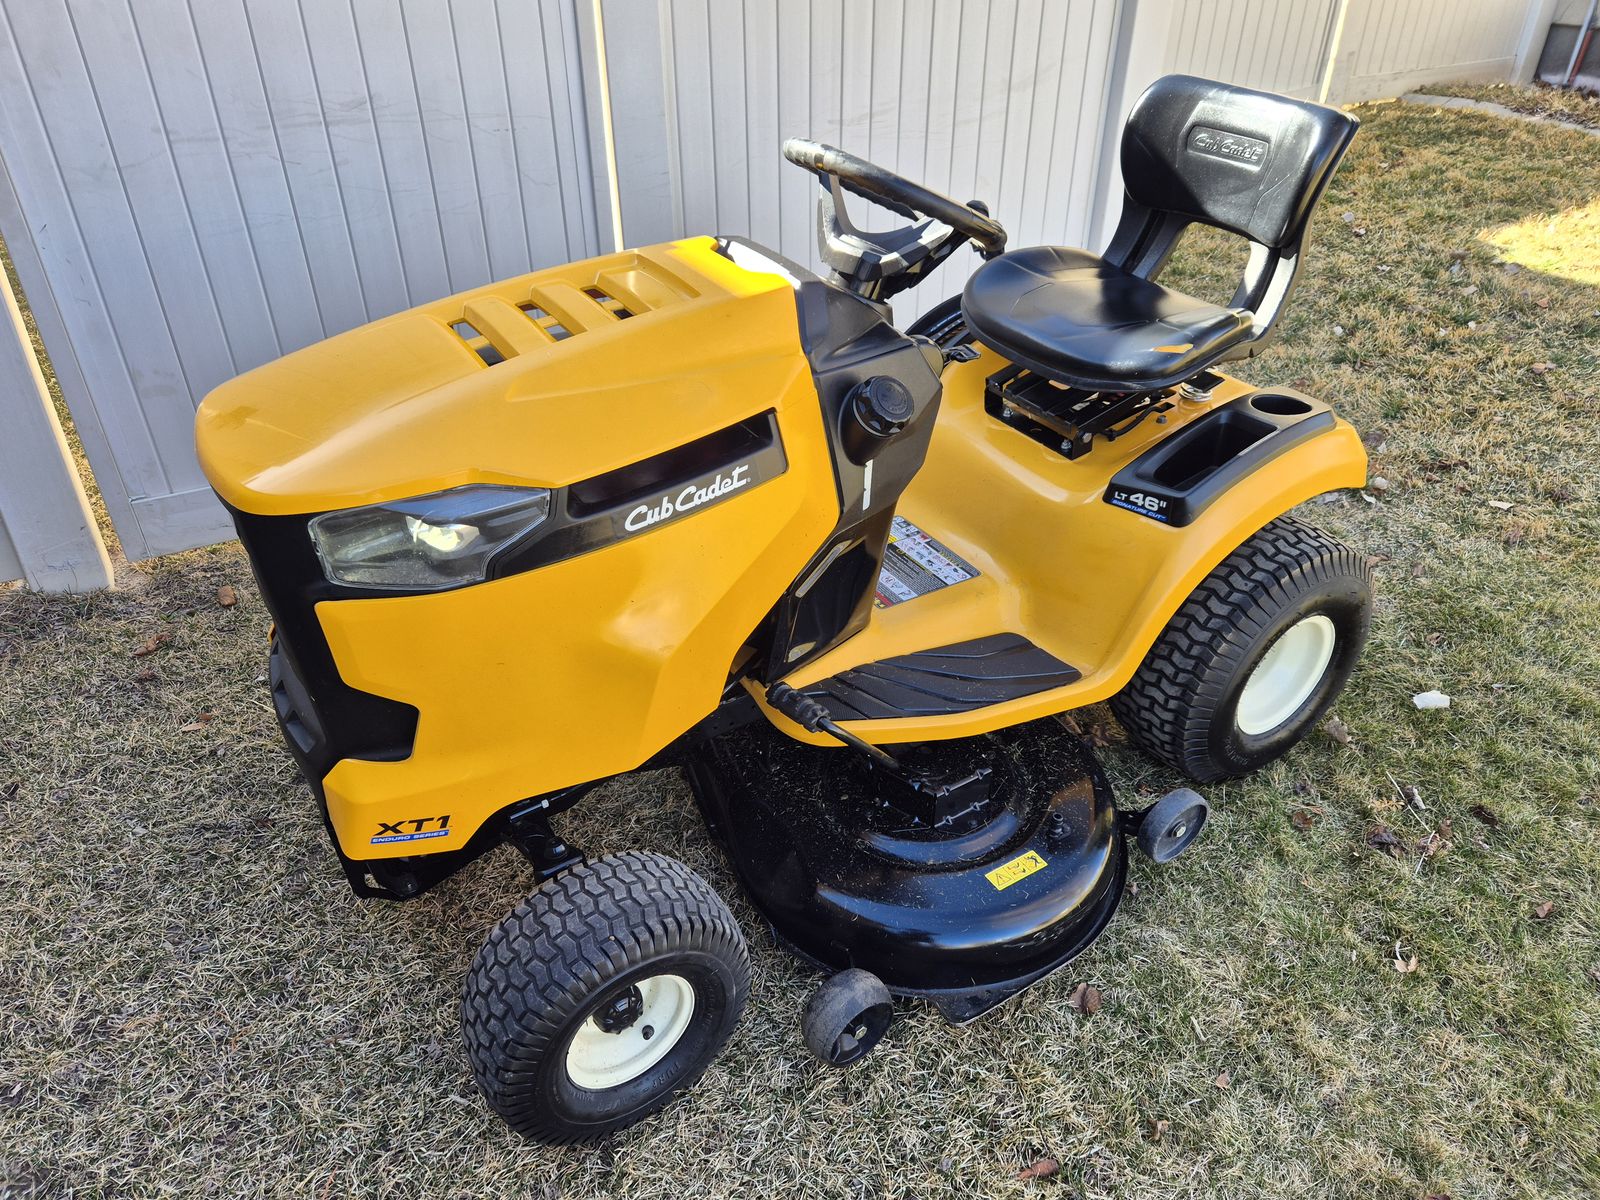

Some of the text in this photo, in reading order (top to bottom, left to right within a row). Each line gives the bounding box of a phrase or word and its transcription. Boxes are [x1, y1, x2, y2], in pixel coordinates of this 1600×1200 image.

[1219, 139, 1263, 161] Cadet
[624, 464, 749, 532] Cub Cadet
[1111, 499, 1148, 515] SIGNATURE
[1114, 490, 1168, 512] LT 46"
[372, 815, 451, 837] XT1
[372, 831, 446, 843] ENDURO SERIES
